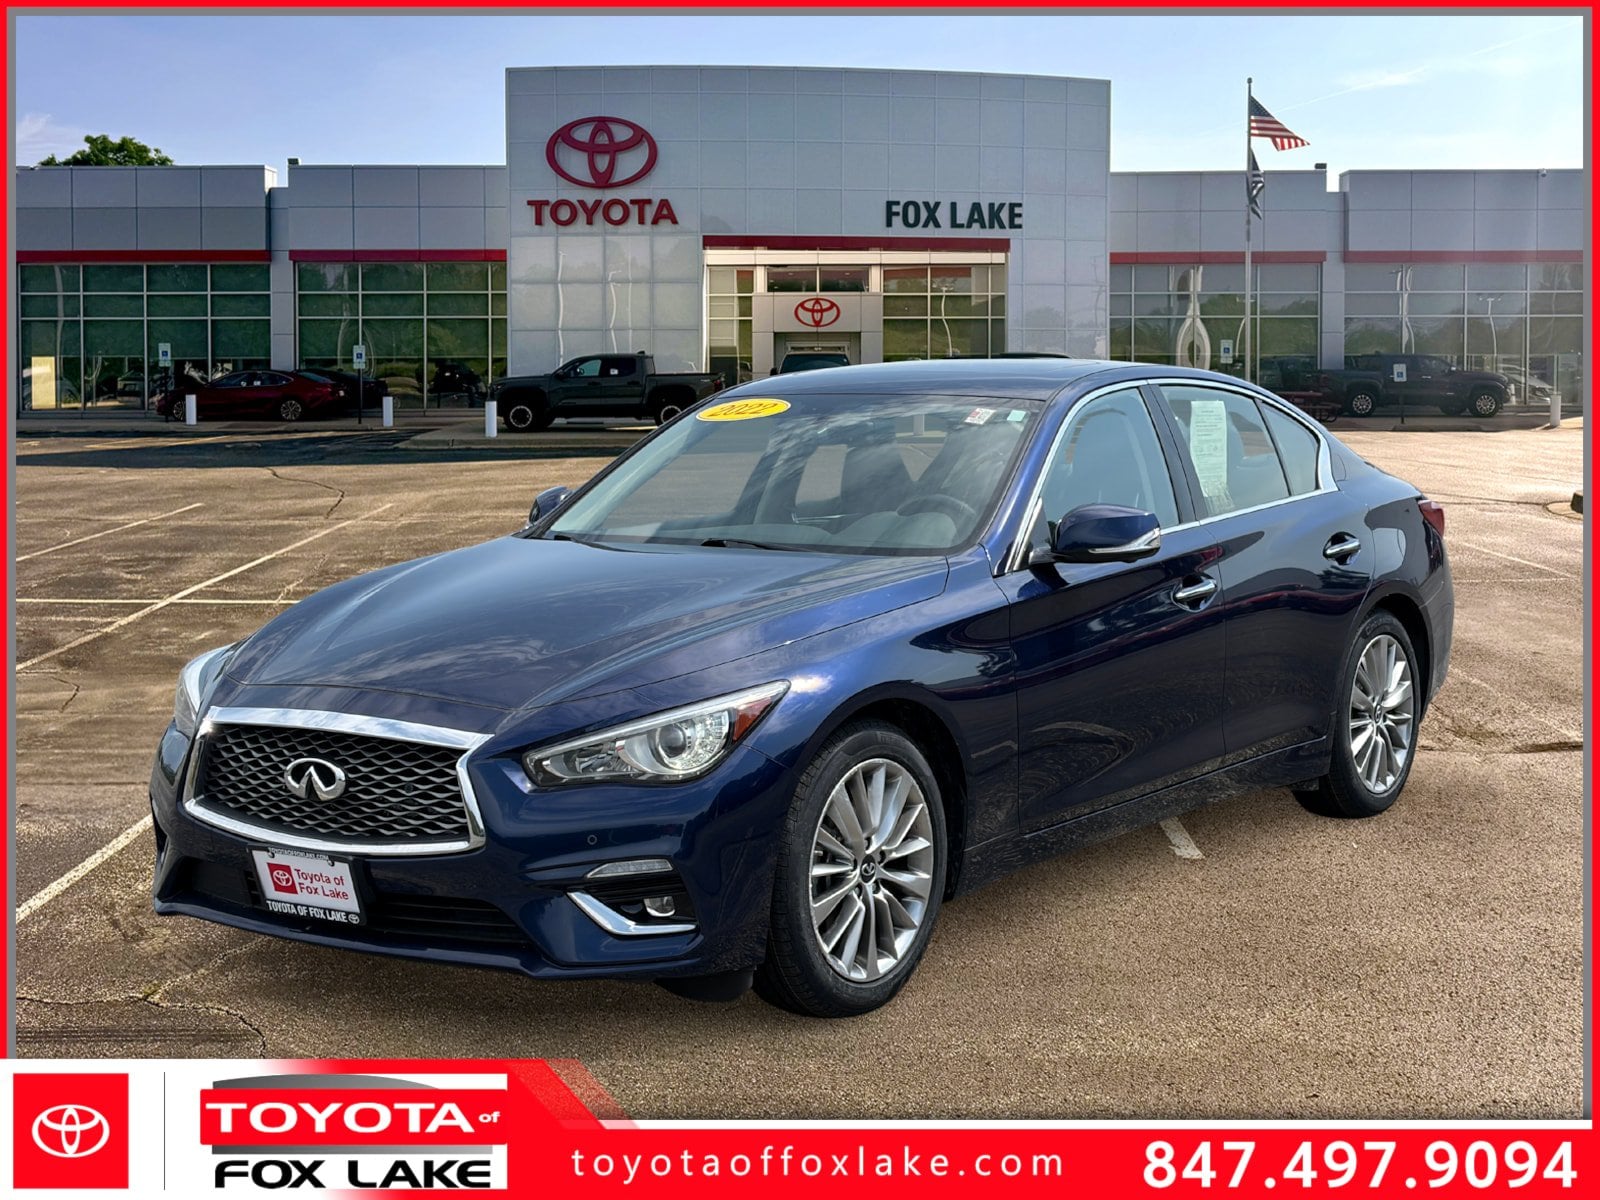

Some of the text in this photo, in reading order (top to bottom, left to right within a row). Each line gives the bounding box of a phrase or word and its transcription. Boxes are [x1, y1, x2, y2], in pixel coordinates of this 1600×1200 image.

[527, 199, 679, 227] TOYOTA
[885, 200, 1023, 230] FOX LAKE
[707, 403, 779, 417] 2022
[294, 868, 345, 886] Toyota of
[298, 883, 349, 900] Fox Lake
[266, 900, 348, 923] TOYOTA OF FOX LAKE
